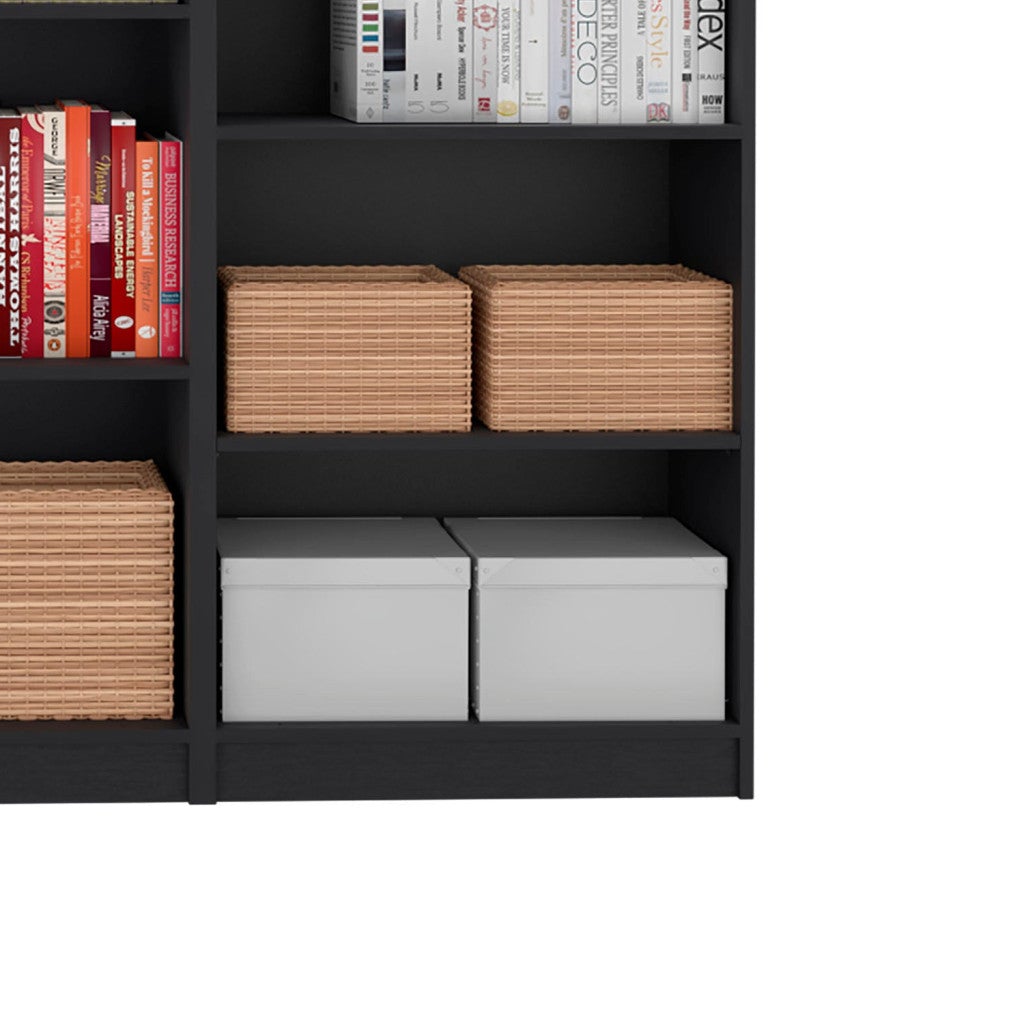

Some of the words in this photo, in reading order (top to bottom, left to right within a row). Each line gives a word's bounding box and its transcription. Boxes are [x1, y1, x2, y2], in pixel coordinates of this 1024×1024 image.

[501, 8, 510, 31] YOUR
[647, 16, 669, 68] Style
[501, 33, 510, 53] TIME
[501, 64, 510, 84] NOW
[602, 33, 617, 106] PRINCIPLES
[702, 95, 723, 105] HOW
[9, 128, 20, 235] HARRIS
[142, 158, 153, 170] To
[142, 171, 154, 188] Kill
[165, 173, 177, 226] BUSINESS
[114, 214, 124, 279] LANDSCAPES
[125, 191, 135, 257] SUSTAINABLE
[139, 198, 154, 256] Mockingbird
[125, 260, 135, 298] ENERGY
[165, 228, 177, 287] RESEARCH
[9, 237, 20, 346] THOMAS
[93, 295, 108, 317] Alicia
[91, 319, 108, 341] Airey
